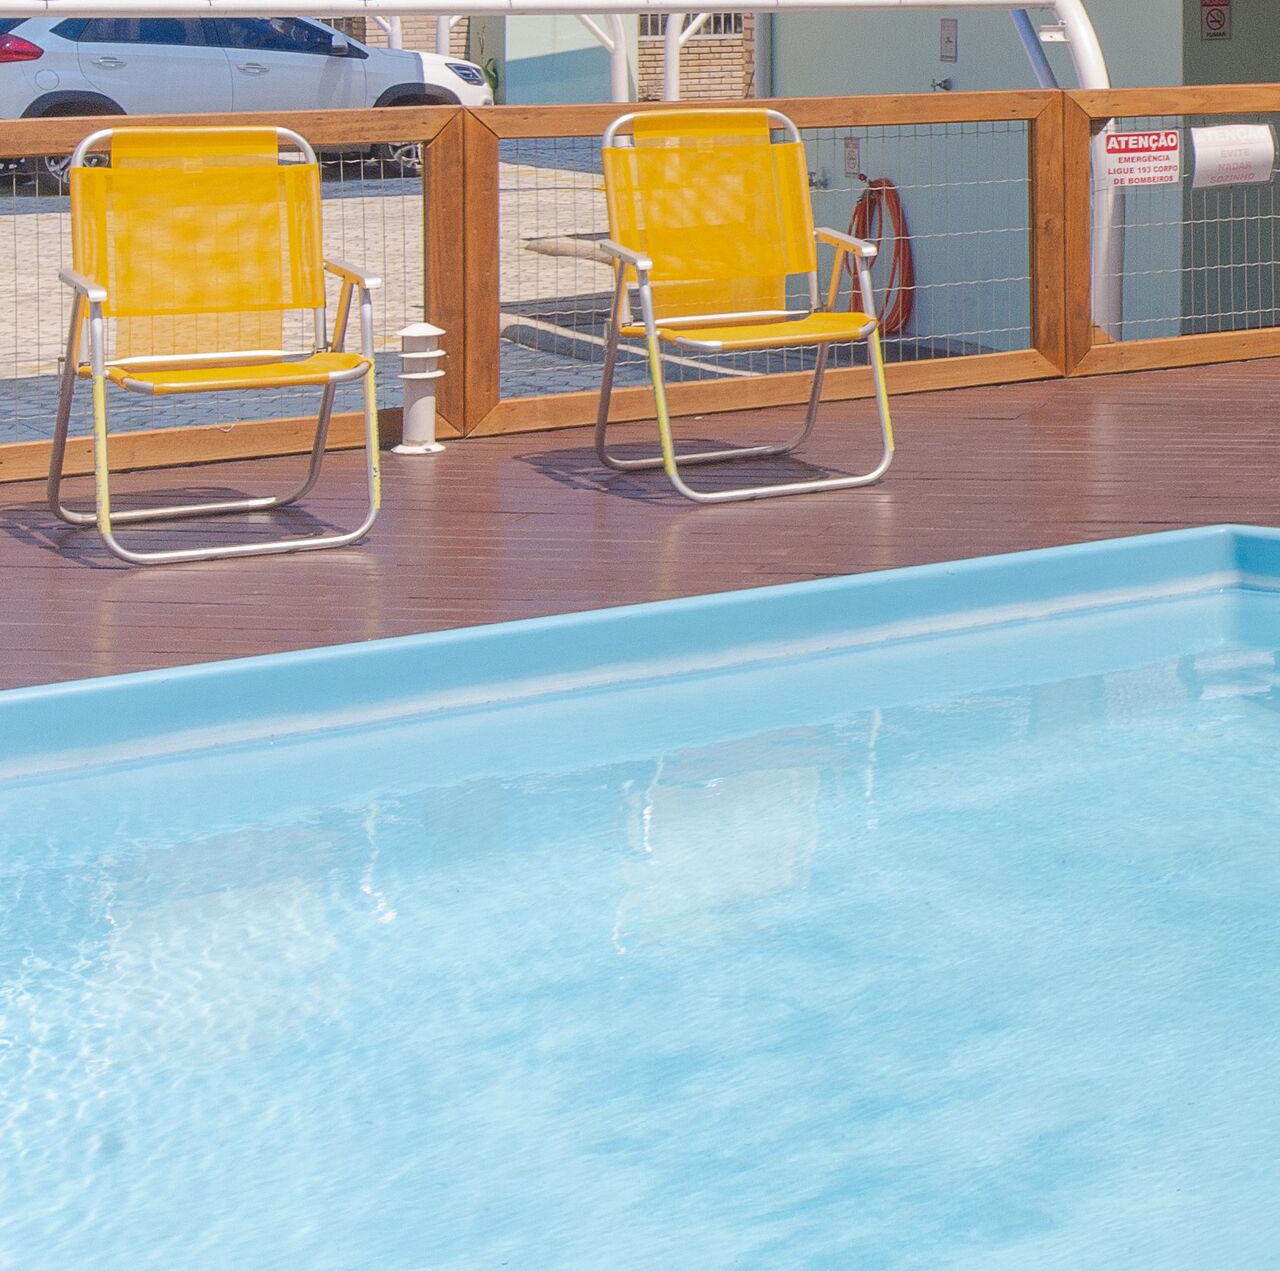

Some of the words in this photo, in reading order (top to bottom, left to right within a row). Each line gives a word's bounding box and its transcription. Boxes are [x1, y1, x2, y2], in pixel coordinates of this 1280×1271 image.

[1107, 133, 1177, 150] ATENÇÃO
[1220, 149, 1250, 158] EVITE
[1118, 154, 1170, 163] EMERGÊNCIA
[1217, 161, 1252, 171] NADAR
[1128, 175, 1173, 184] BOMBEIROS
[1208, 172, 1255, 184] SOZINHO
